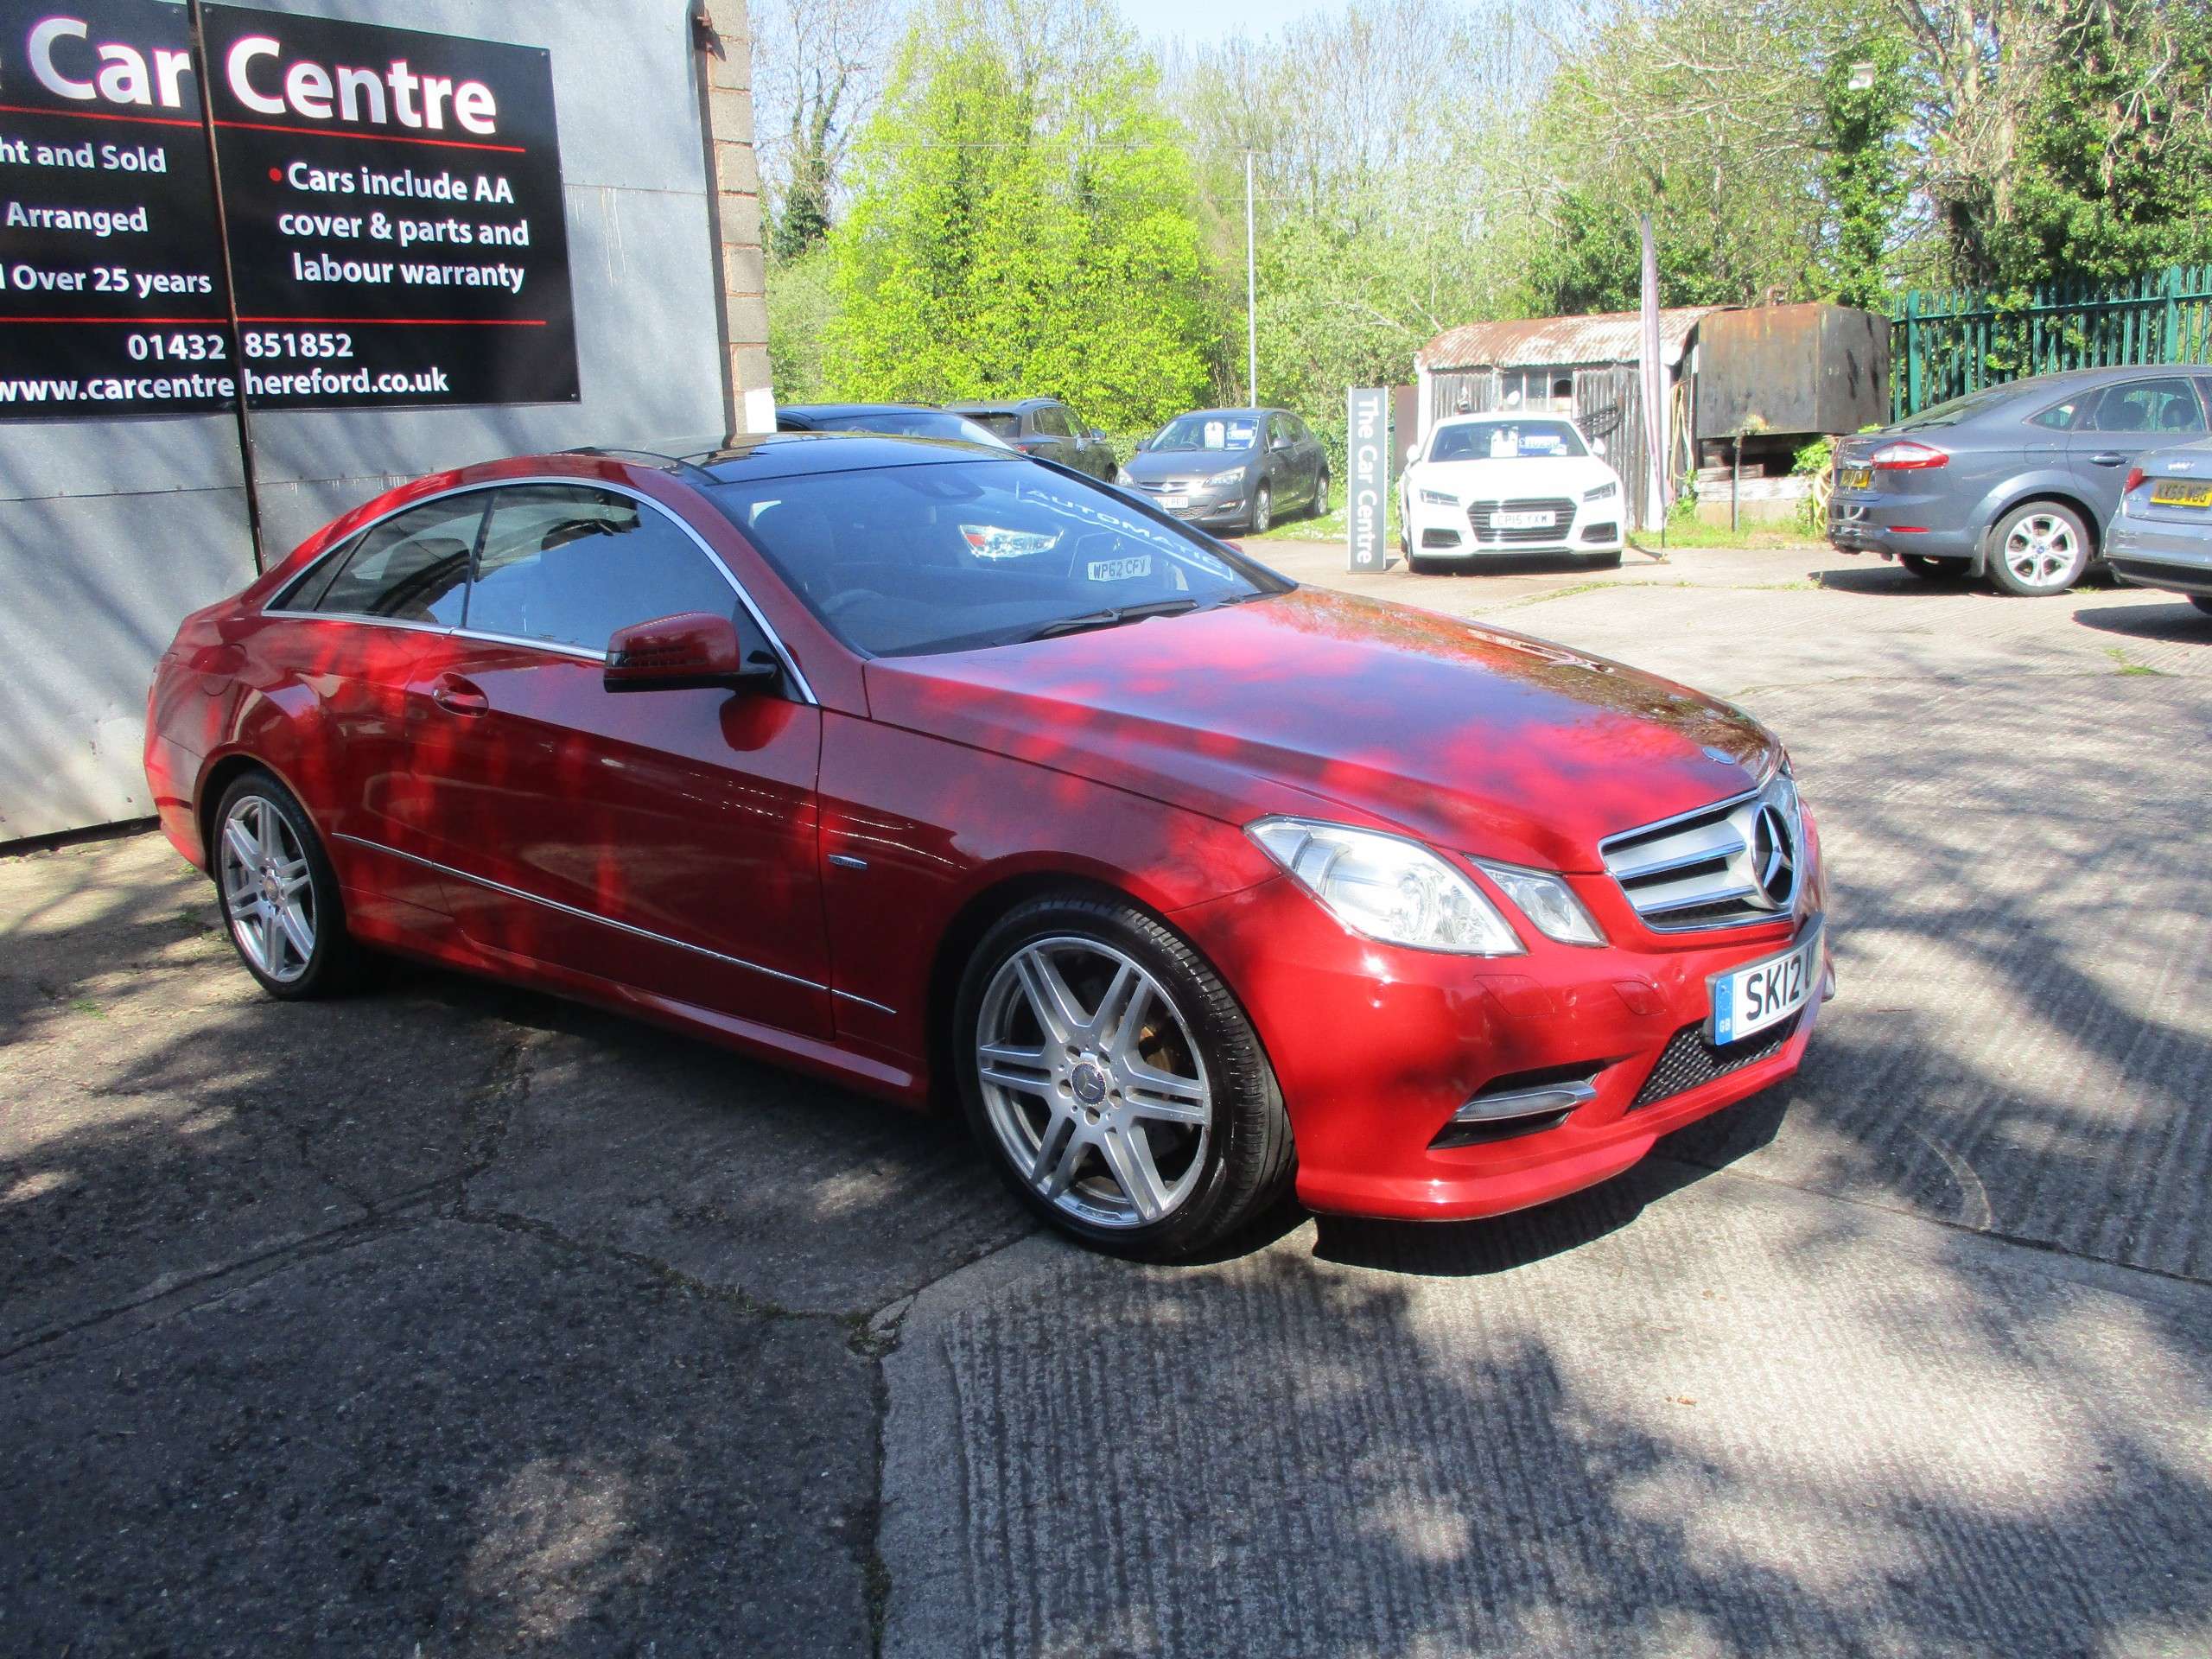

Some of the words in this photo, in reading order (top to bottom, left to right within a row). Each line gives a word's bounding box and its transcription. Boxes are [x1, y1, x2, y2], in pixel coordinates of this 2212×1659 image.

[29, 17, 193, 108] Car
[227, 35, 496, 135] Centre
[37, 143, 96, 168] and
[101, 145, 167, 173] Sold
[288, 162, 355, 194] Cars
[361, 166, 467, 200] include
[474, 175, 514, 204] AA
[7, 201, 149, 238] Arranged
[278, 213, 362, 238] cover
[370, 213, 392, 239] &
[399, 219, 474, 247] parts
[479, 219, 530, 246] and
[13, 264, 87, 291] Over
[92, 268, 130, 292] 25
[135, 273, 213, 298] years
[293, 252, 394, 283] labour
[399, 263, 525, 294] warranty
[128, 334, 226, 360] 01432
[245, 333, 353, 359] 851852
[1357, 396, 1380, 439] The
[1357, 444, 1378, 484] Car
[1357, 489, 1378, 564] Centre
[1746, 954, 1802, 1020] SK12
